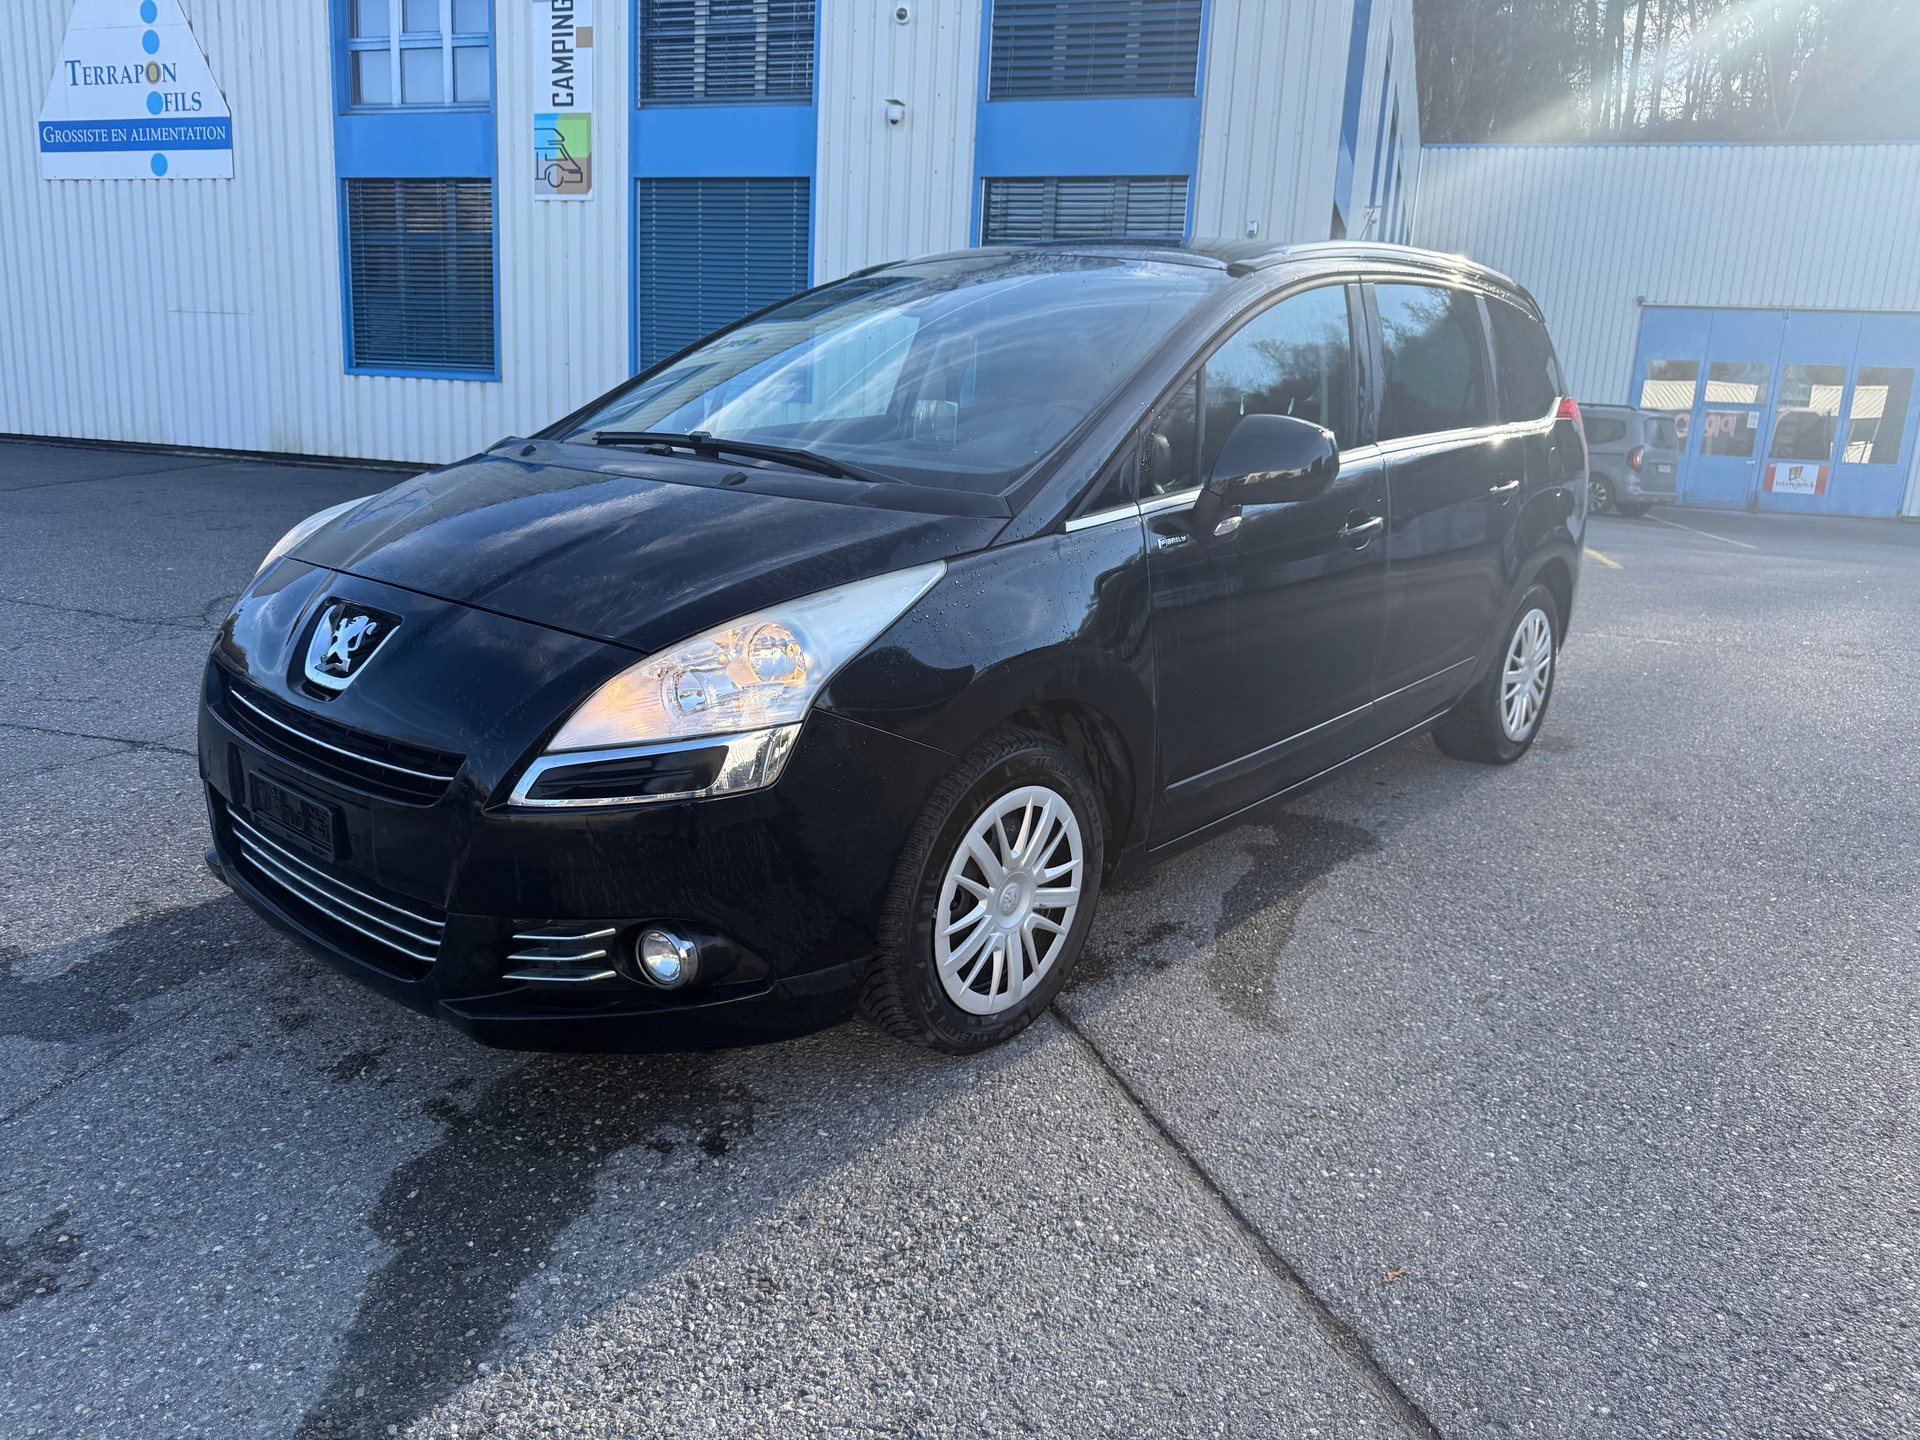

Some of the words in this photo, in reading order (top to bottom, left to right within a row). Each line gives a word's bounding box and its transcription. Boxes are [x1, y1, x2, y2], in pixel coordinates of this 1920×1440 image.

[551, 0, 574, 107] CAMPING
[65, 60, 177, 86] TERRAPON
[163, 91, 202, 112] FILS
[43, 126, 109, 143] GROSSISTE
[111, 129, 126, 142] EN
[130, 126, 226, 142] ALIMENTATION
